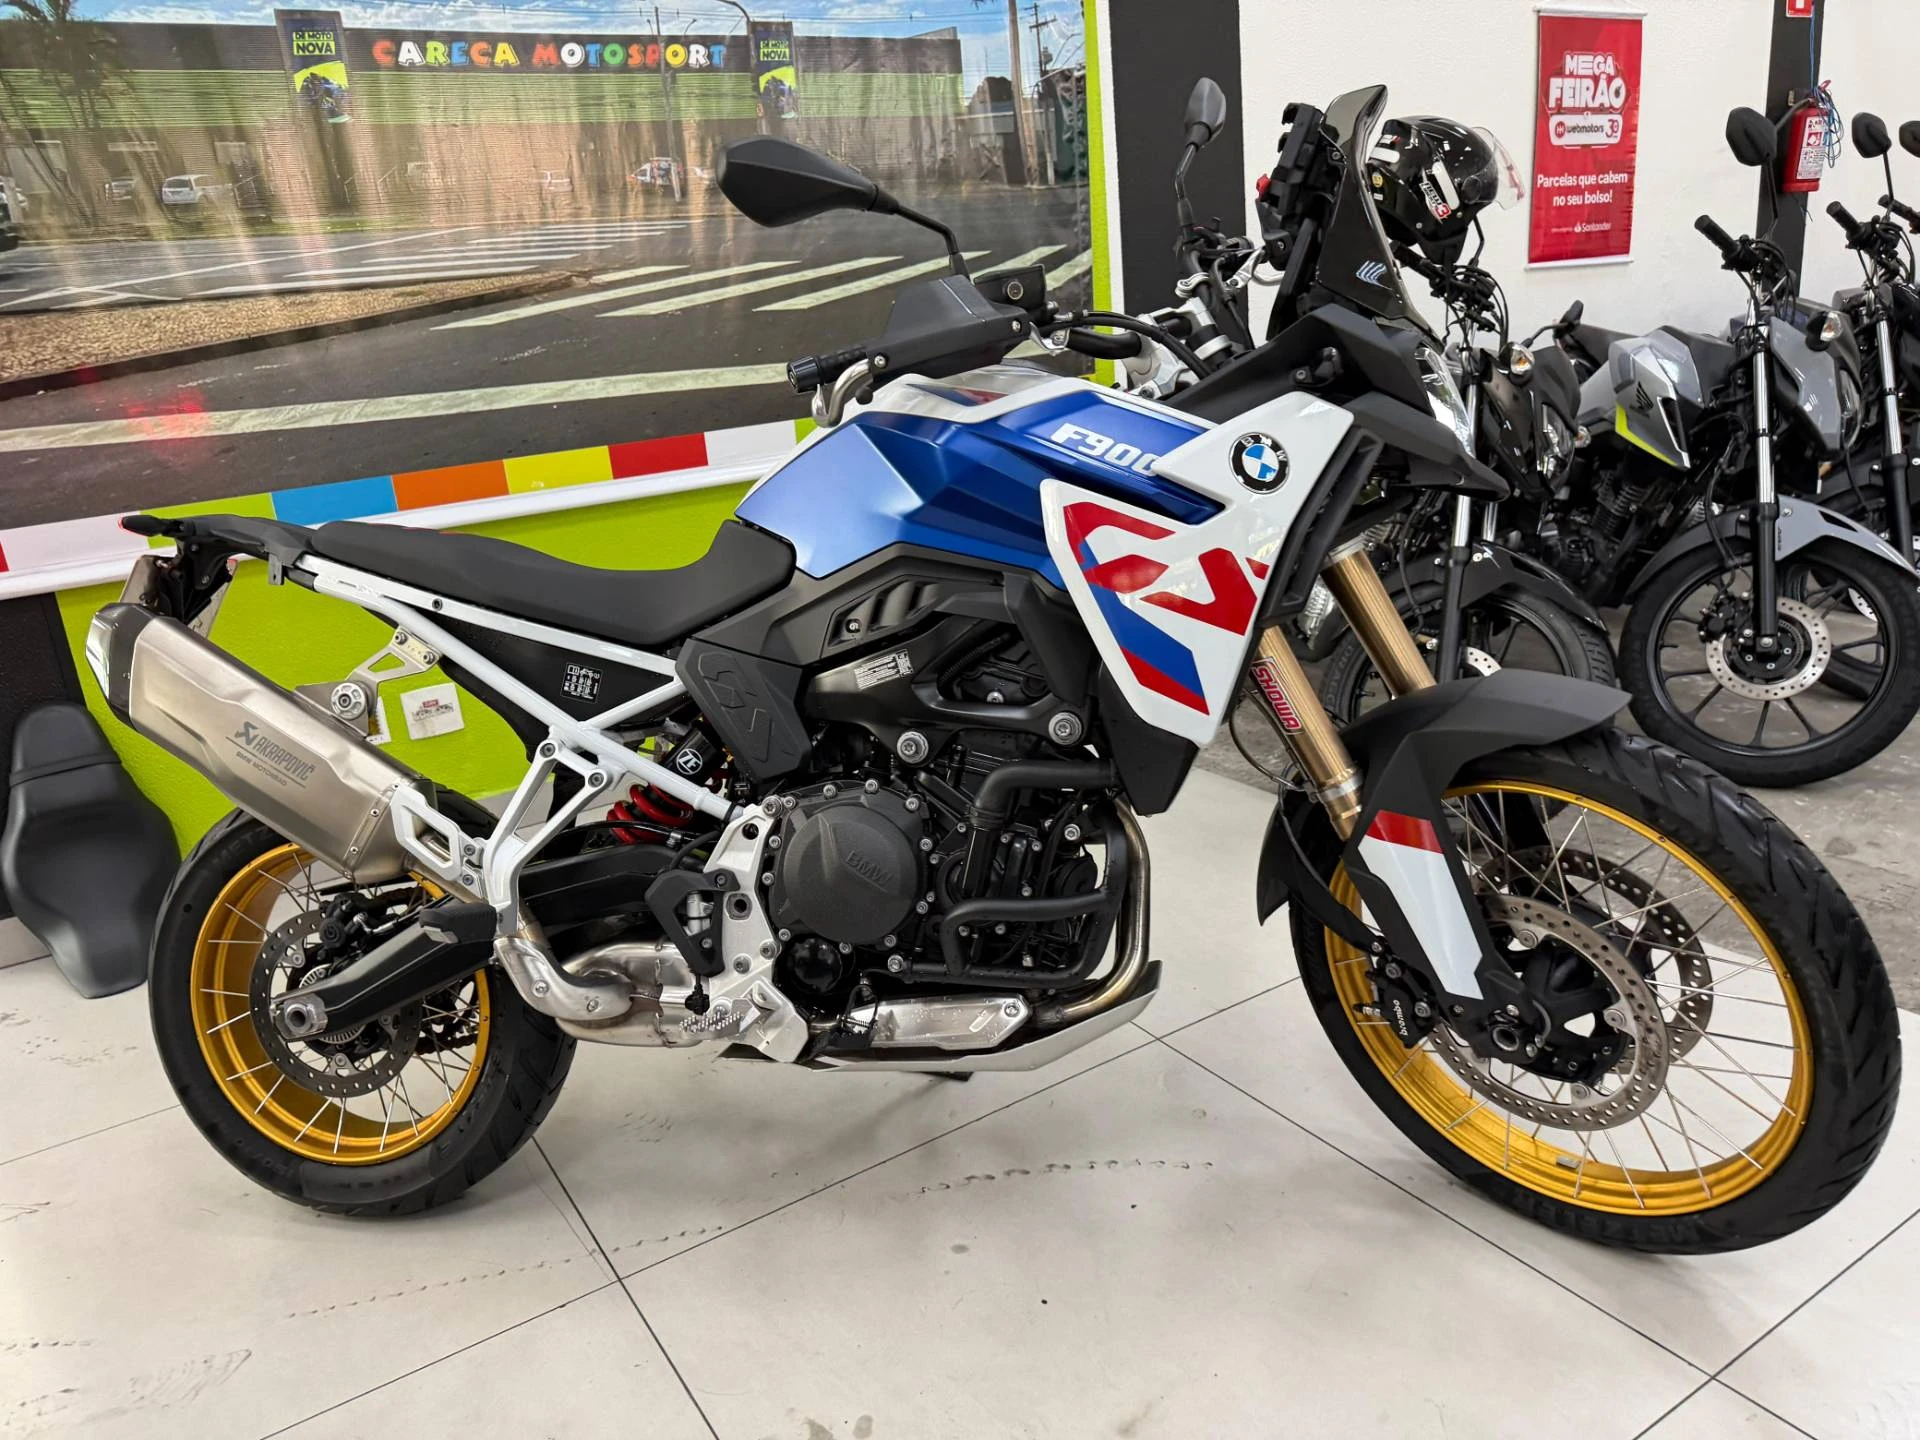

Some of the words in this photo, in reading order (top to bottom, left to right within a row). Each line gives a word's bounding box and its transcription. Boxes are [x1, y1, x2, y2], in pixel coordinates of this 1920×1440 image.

[296, 43, 333, 54] NOVA
[372, 40, 520, 67] CARECA
[532, 42, 727, 69] MOTOSPORT
[762, 51, 787, 60] NOVA
[1565, 54, 1615, 76] MEGA
[1548, 73, 1626, 109] FEIRÃO
[1566, 124, 1604, 133] webmotors
[1537, 172, 1577, 188] Parcelas
[1578, 174, 1596, 188] que
[1598, 170, 1628, 184] cabem
[1553, 195, 1565, 206] no
[1567, 194, 1582, 205] seu
[1584, 189, 1613, 204] bolso!
[1582, 222, 1611, 232] Santander
[1255, 665, 1302, 730] SHOWA
[845, 849, 896, 885] BMW
[1393, 999, 1408, 1036] brembo
